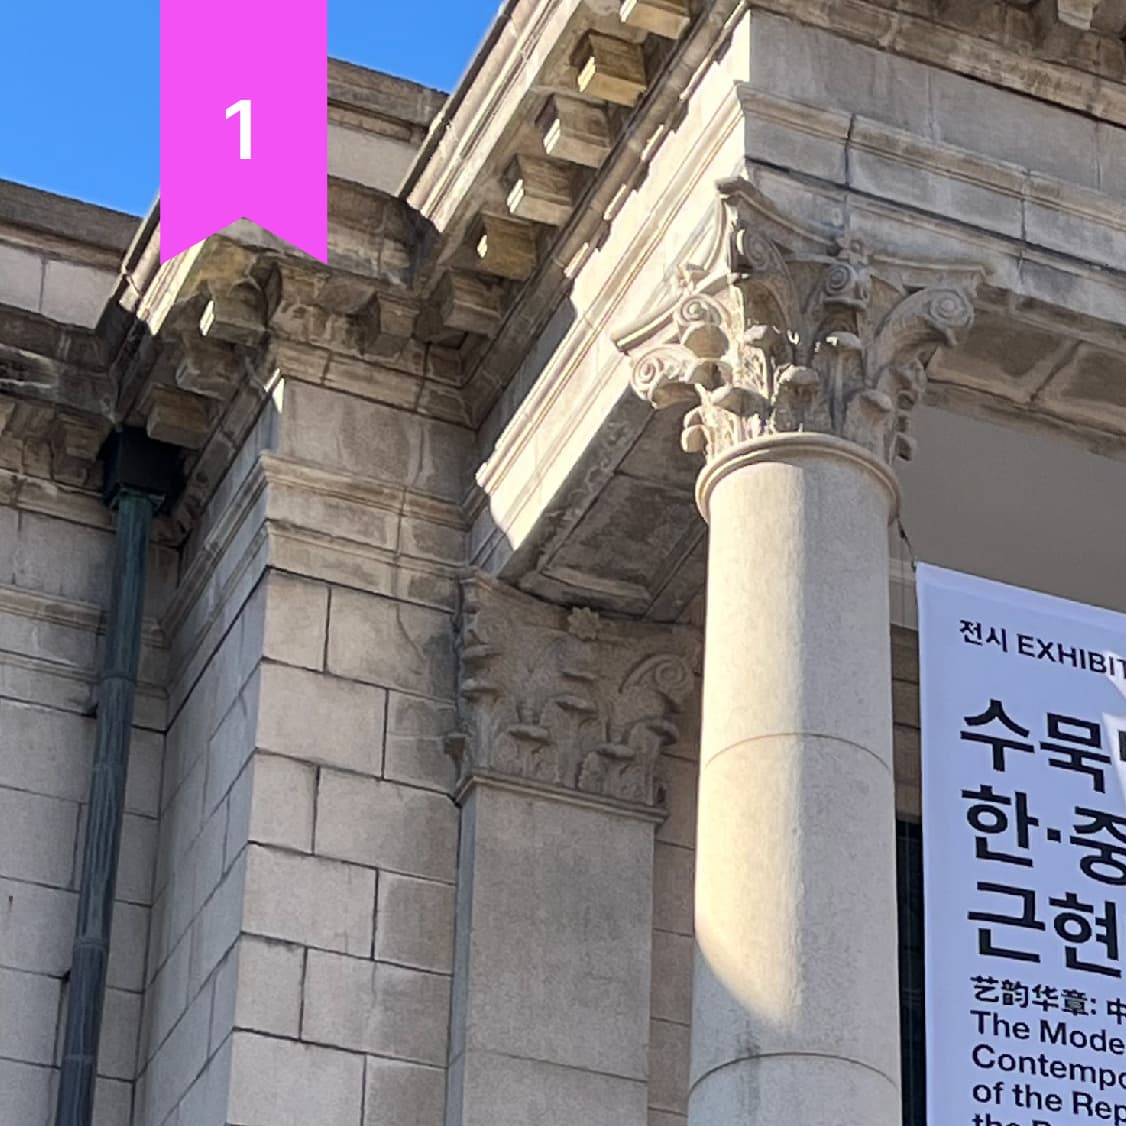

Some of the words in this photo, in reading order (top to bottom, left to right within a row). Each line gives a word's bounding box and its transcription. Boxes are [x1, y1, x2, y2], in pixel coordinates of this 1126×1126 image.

[959, 619, 1008, 653] 전시
[970, 1009, 1030, 1040] The
[972, 1081, 1005, 1104] of
[1011, 1083, 1063, 1113] the
